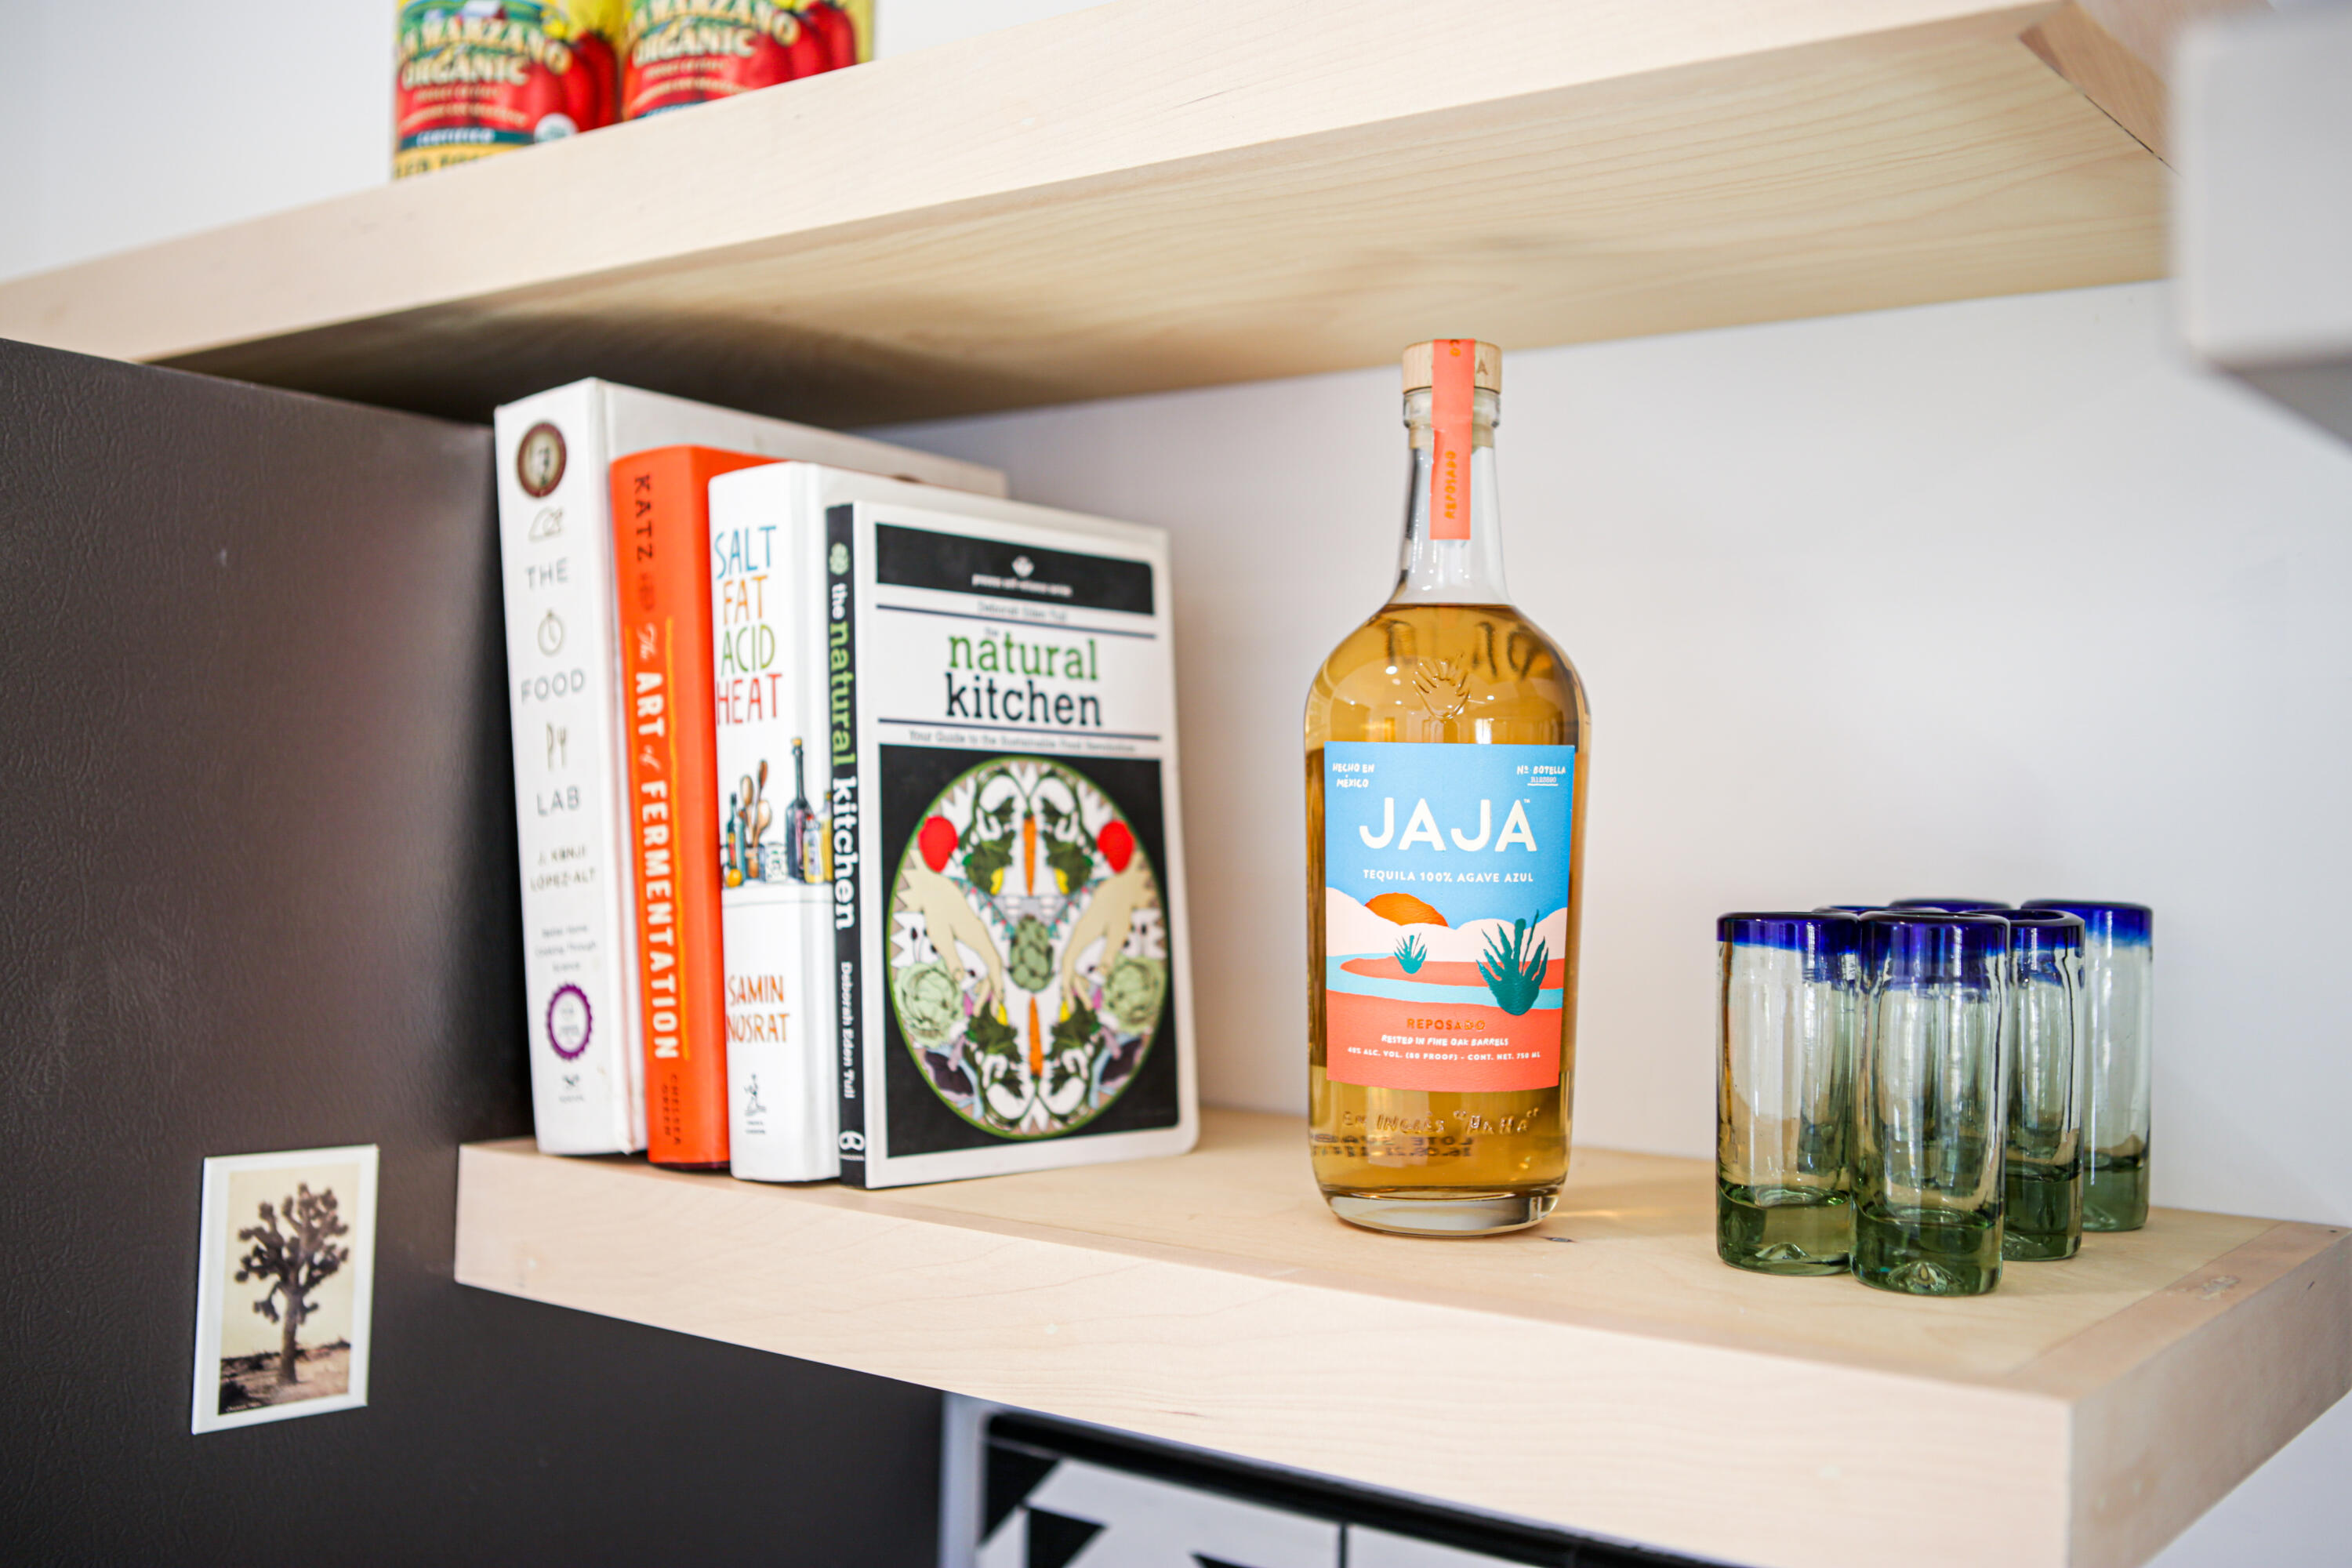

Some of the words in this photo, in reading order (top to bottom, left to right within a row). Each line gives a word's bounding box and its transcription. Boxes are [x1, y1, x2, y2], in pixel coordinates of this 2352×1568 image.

[634, 474, 653, 561] KATZ
[714, 524, 777, 579] SALT
[526, 557, 568, 589] THE
[724, 575, 768, 626] FAT
[832, 583, 848, 619] the
[720, 624, 775, 677] ACID
[949, 632, 1099, 681] natural
[521, 669, 585, 702] FOOD
[717, 673, 782, 726] HEAT
[830, 621, 856, 767] natural
[946, 672, 1102, 726] kitchen
[636, 672, 665, 737] ART
[1332, 763, 1360, 773] HECHO
[1362, 763, 1375, 773] EN
[1337, 774, 1369, 788] MÉXICO
[1533, 766, 1566, 775] BOTELLA
[536, 786, 579, 815] LAB
[1359, 797, 1537, 852] JAJA
[833, 775, 859, 930] kitchen
[1363, 869, 1416, 882] TEQUILA
[1420, 871, 1453, 882] 100%
[1457, 873, 1500, 883] AGAVE
[1504, 873, 1534, 882] AZUL
[641, 780, 679, 1058] FERMENTATION
[728, 975, 784, 1006] SAMIN
[841, 961, 854, 1026] Deborah
[726, 1013, 789, 1044] NOSRAT
[1381, 1034, 1414, 1045] RESTED
[1415, 1036, 1425, 1045] IN
[1427, 1037, 1448, 1047] FINE
[1450, 1038, 1468, 1047] OAK
[1471, 1038, 1509, 1047] BARRELS
[1406, 1018, 1486, 1030] REPOSADO
[842, 1028, 855, 1067] Eden
[1383, 1050, 1403, 1058] VOL.
[844, 1069, 855, 1098] Tull
